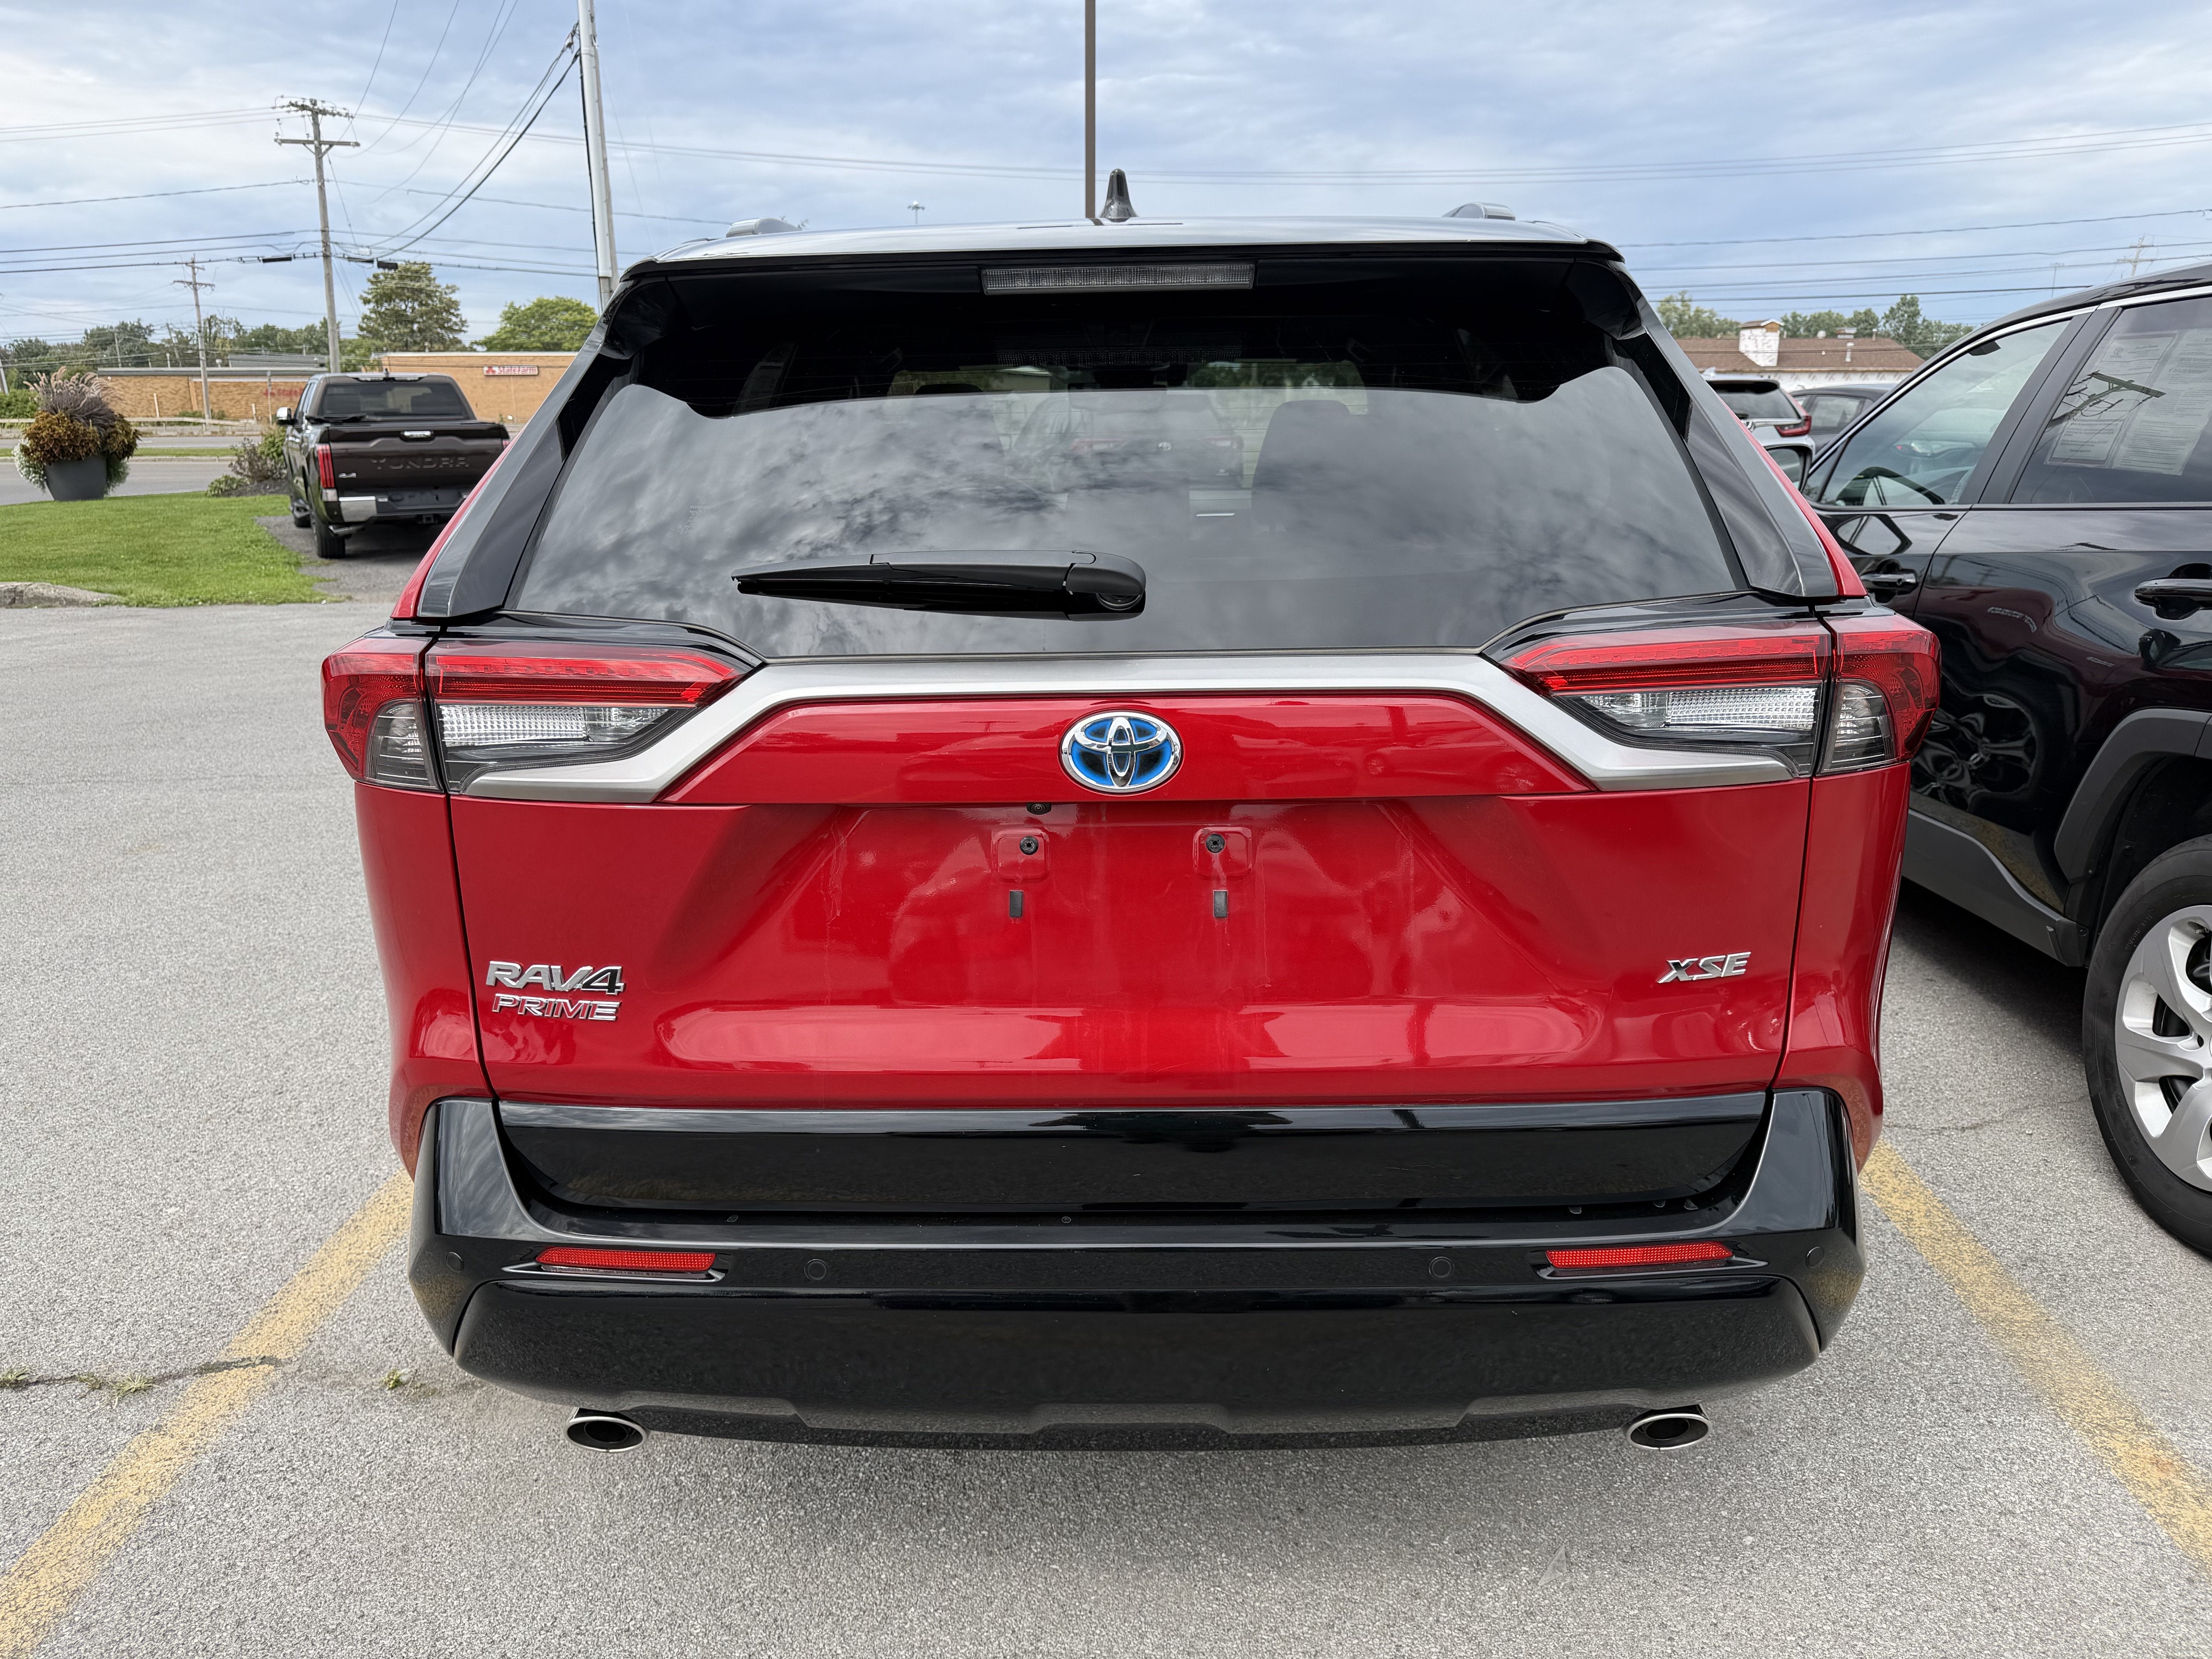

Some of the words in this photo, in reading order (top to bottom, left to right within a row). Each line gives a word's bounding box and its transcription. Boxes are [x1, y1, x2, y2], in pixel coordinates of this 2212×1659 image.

[371, 457, 469, 470] TUNDRA
[486, 960, 626, 996] RAV4
[1656, 951, 1751, 984] XSE
[492, 993, 622, 1021] PRIME
